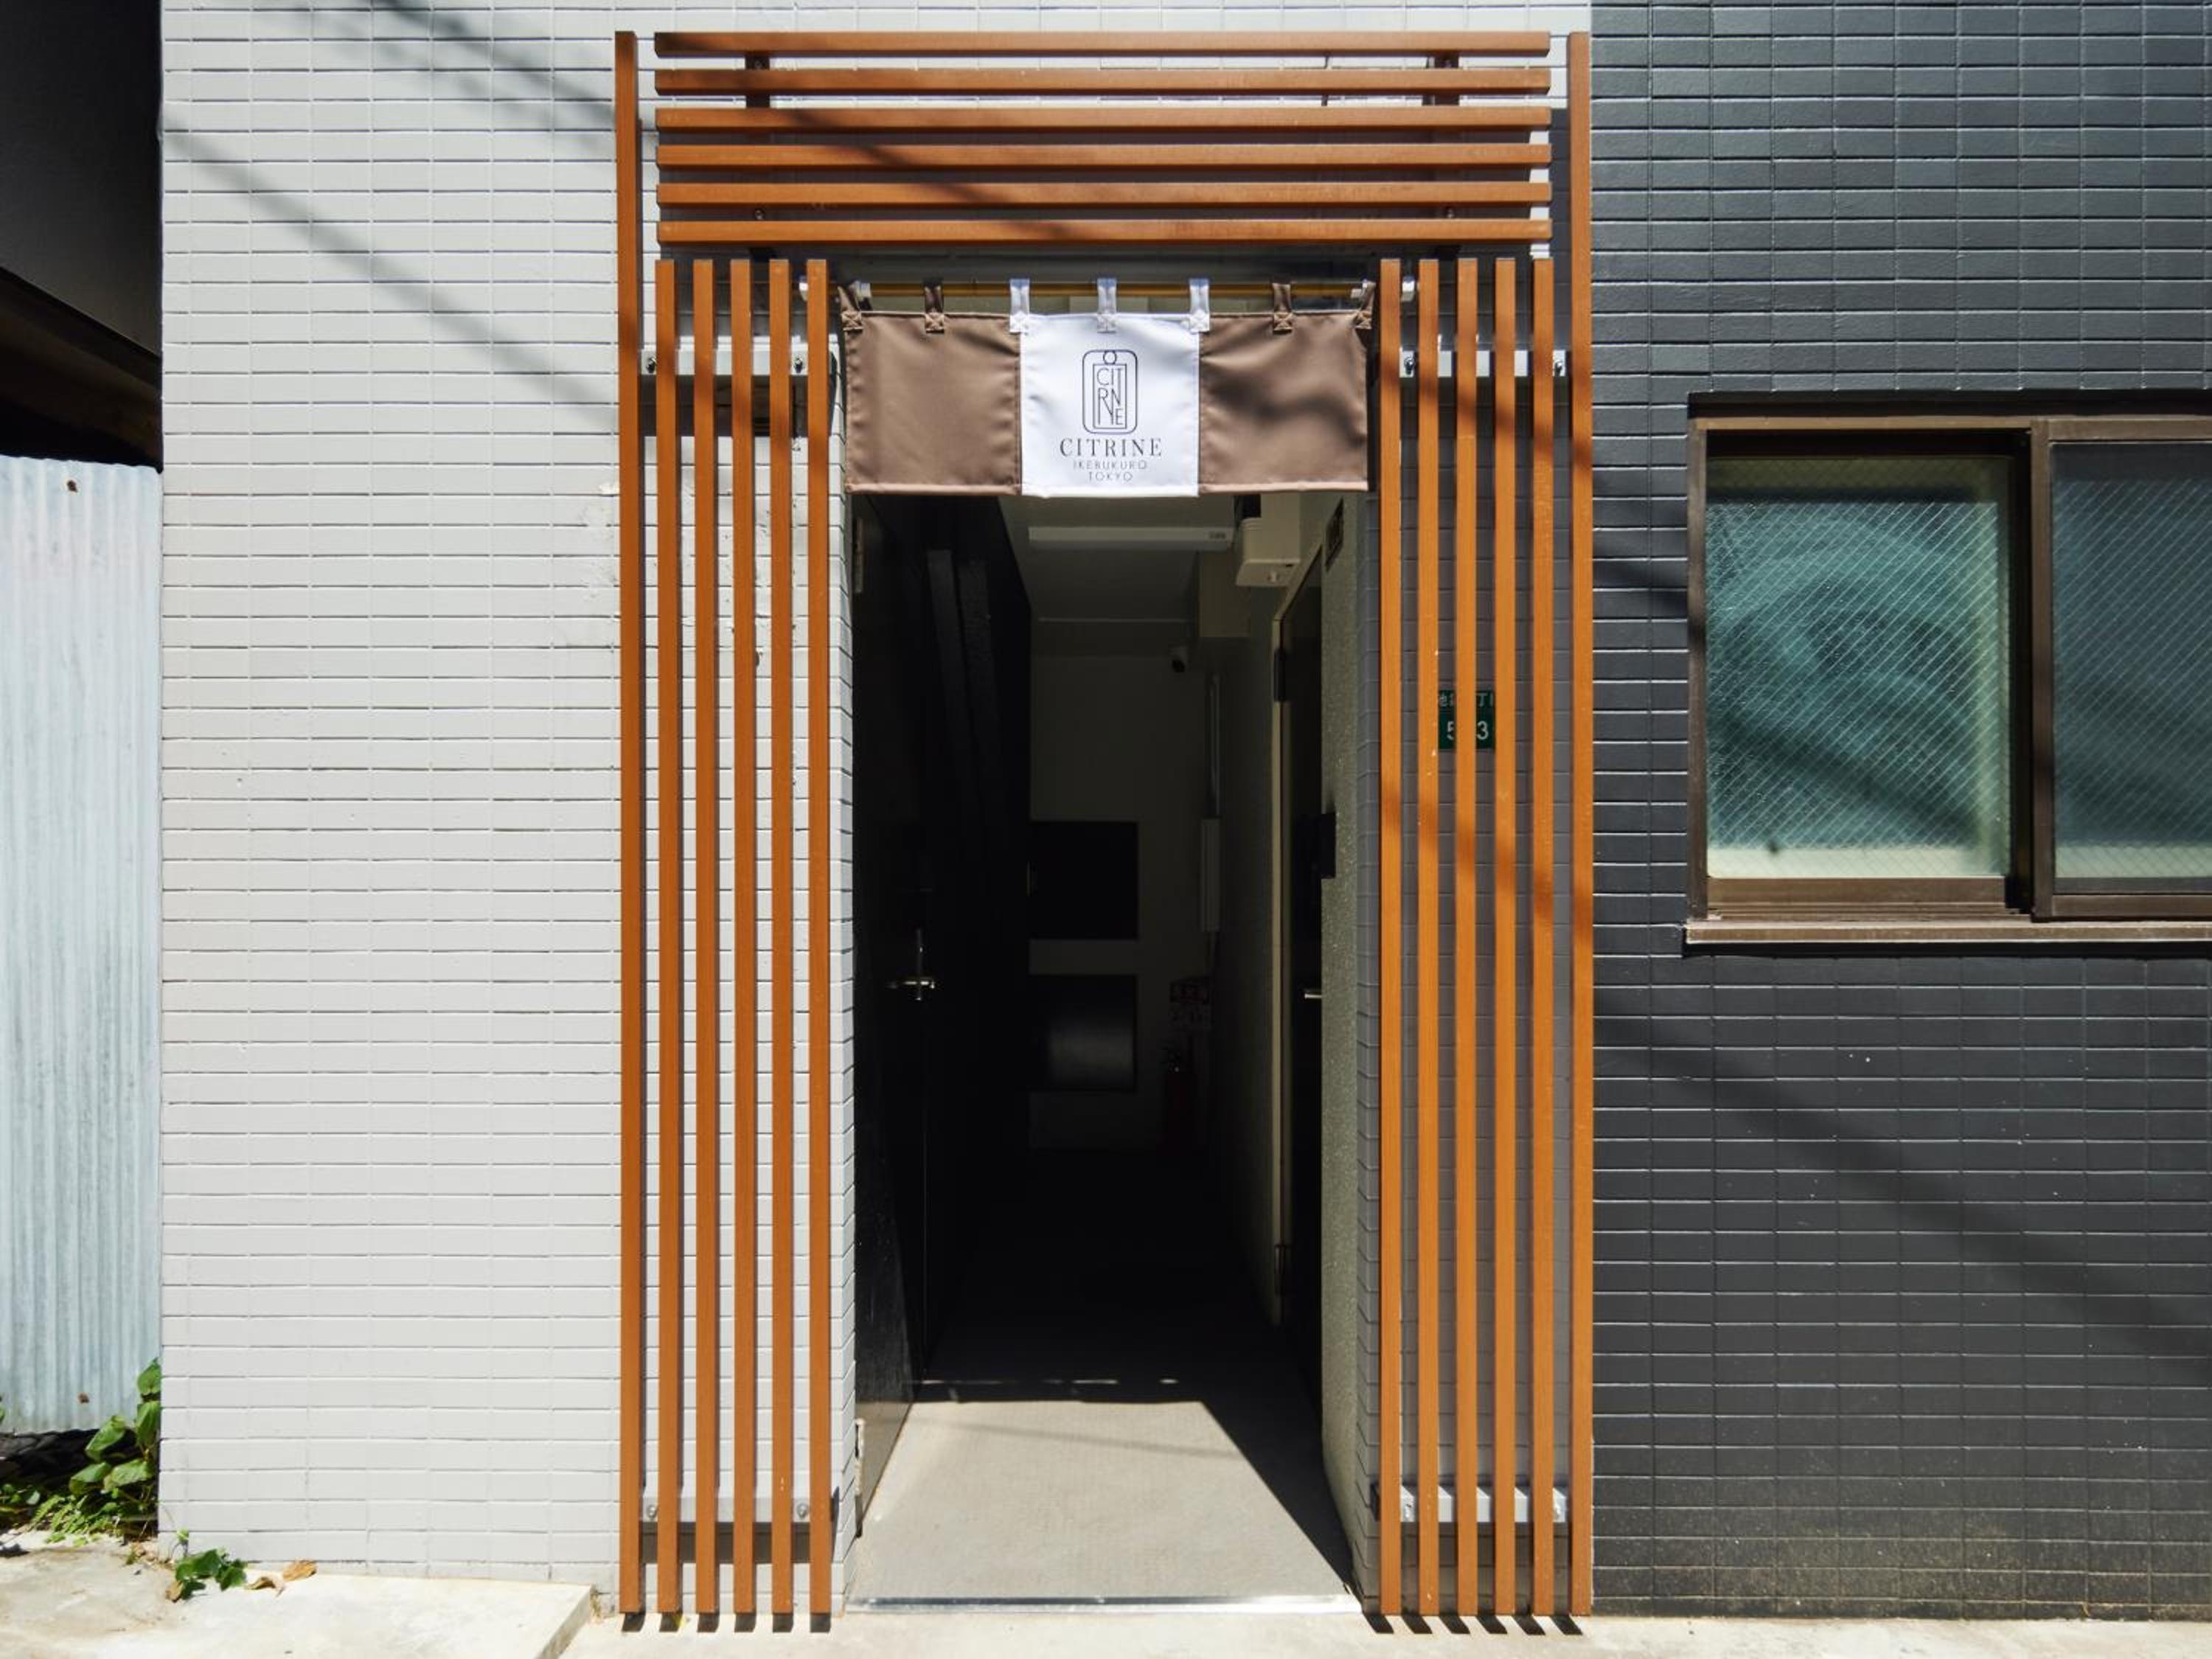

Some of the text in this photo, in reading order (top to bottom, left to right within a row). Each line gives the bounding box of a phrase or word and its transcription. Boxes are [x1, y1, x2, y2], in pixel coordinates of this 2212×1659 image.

[1060, 438, 1161, 456] CITRINE
[1073, 460, 1147, 470] IKEBUKURO
[1088, 472, 1133, 481] TOKYO
